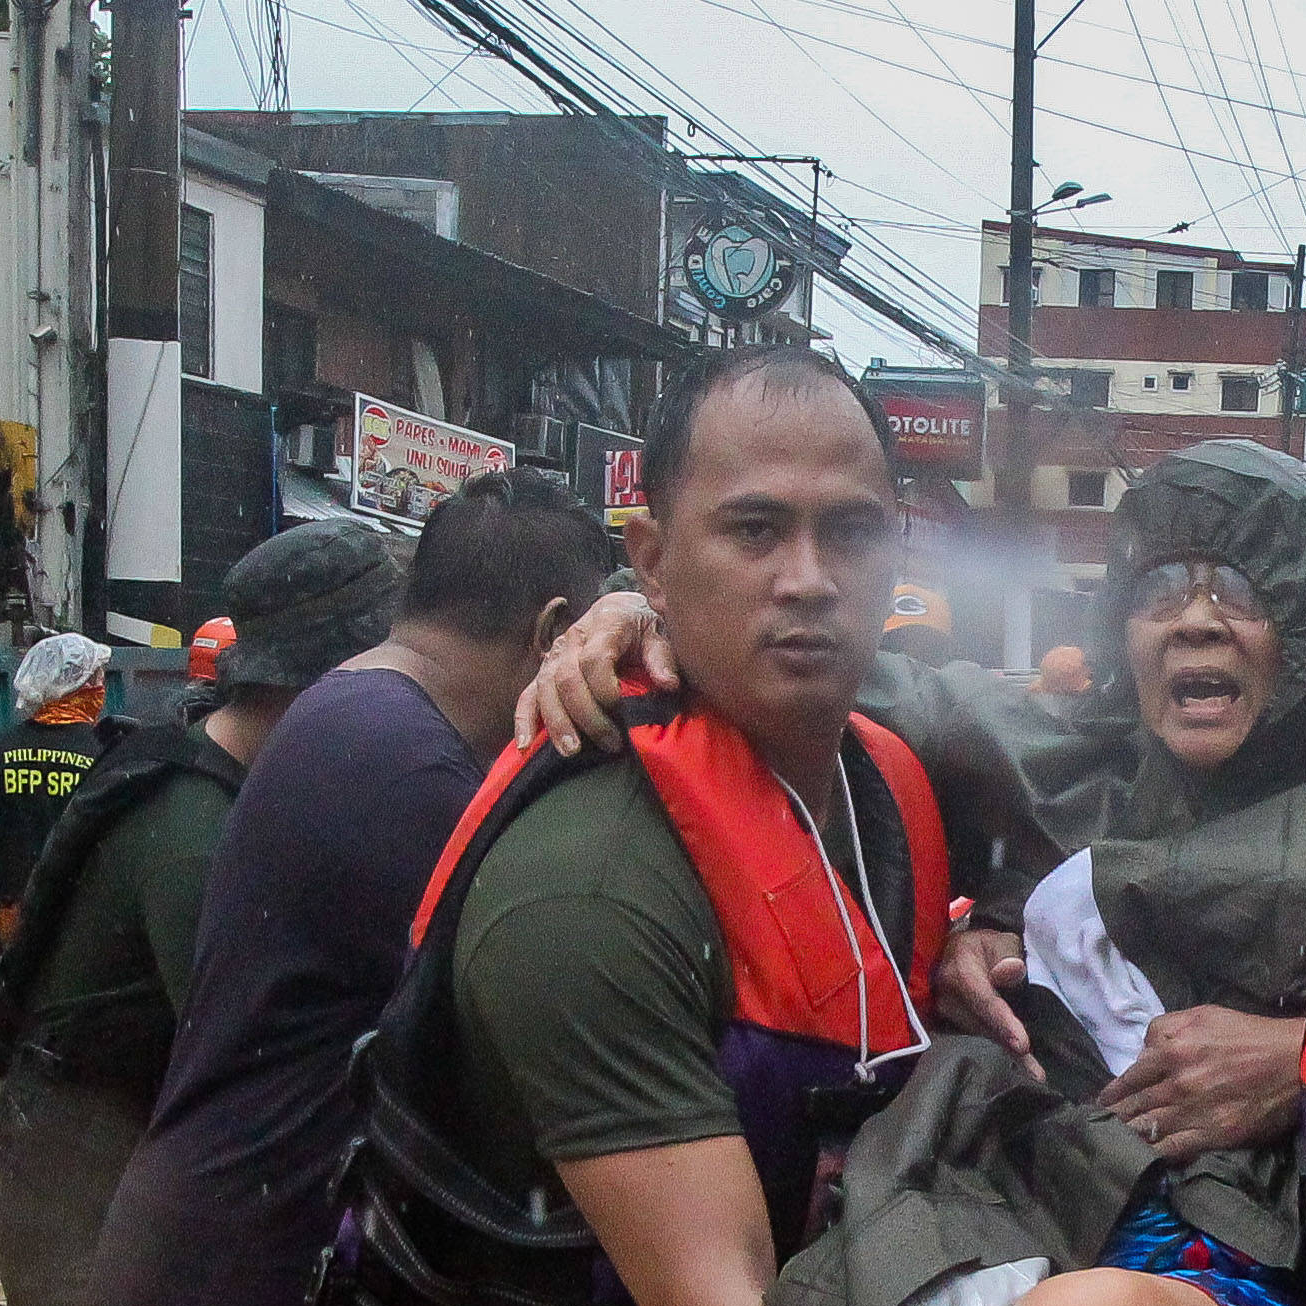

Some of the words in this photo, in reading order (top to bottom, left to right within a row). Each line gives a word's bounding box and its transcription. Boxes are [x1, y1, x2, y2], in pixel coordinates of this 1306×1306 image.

[396, 418, 435, 446] PARES
[448, 436, 481, 460] MAMI
[406, 448, 433, 470] UNLI
[3, 748, 95, 770] PHILIPPINES
[3, 768, 42, 794] BFP
